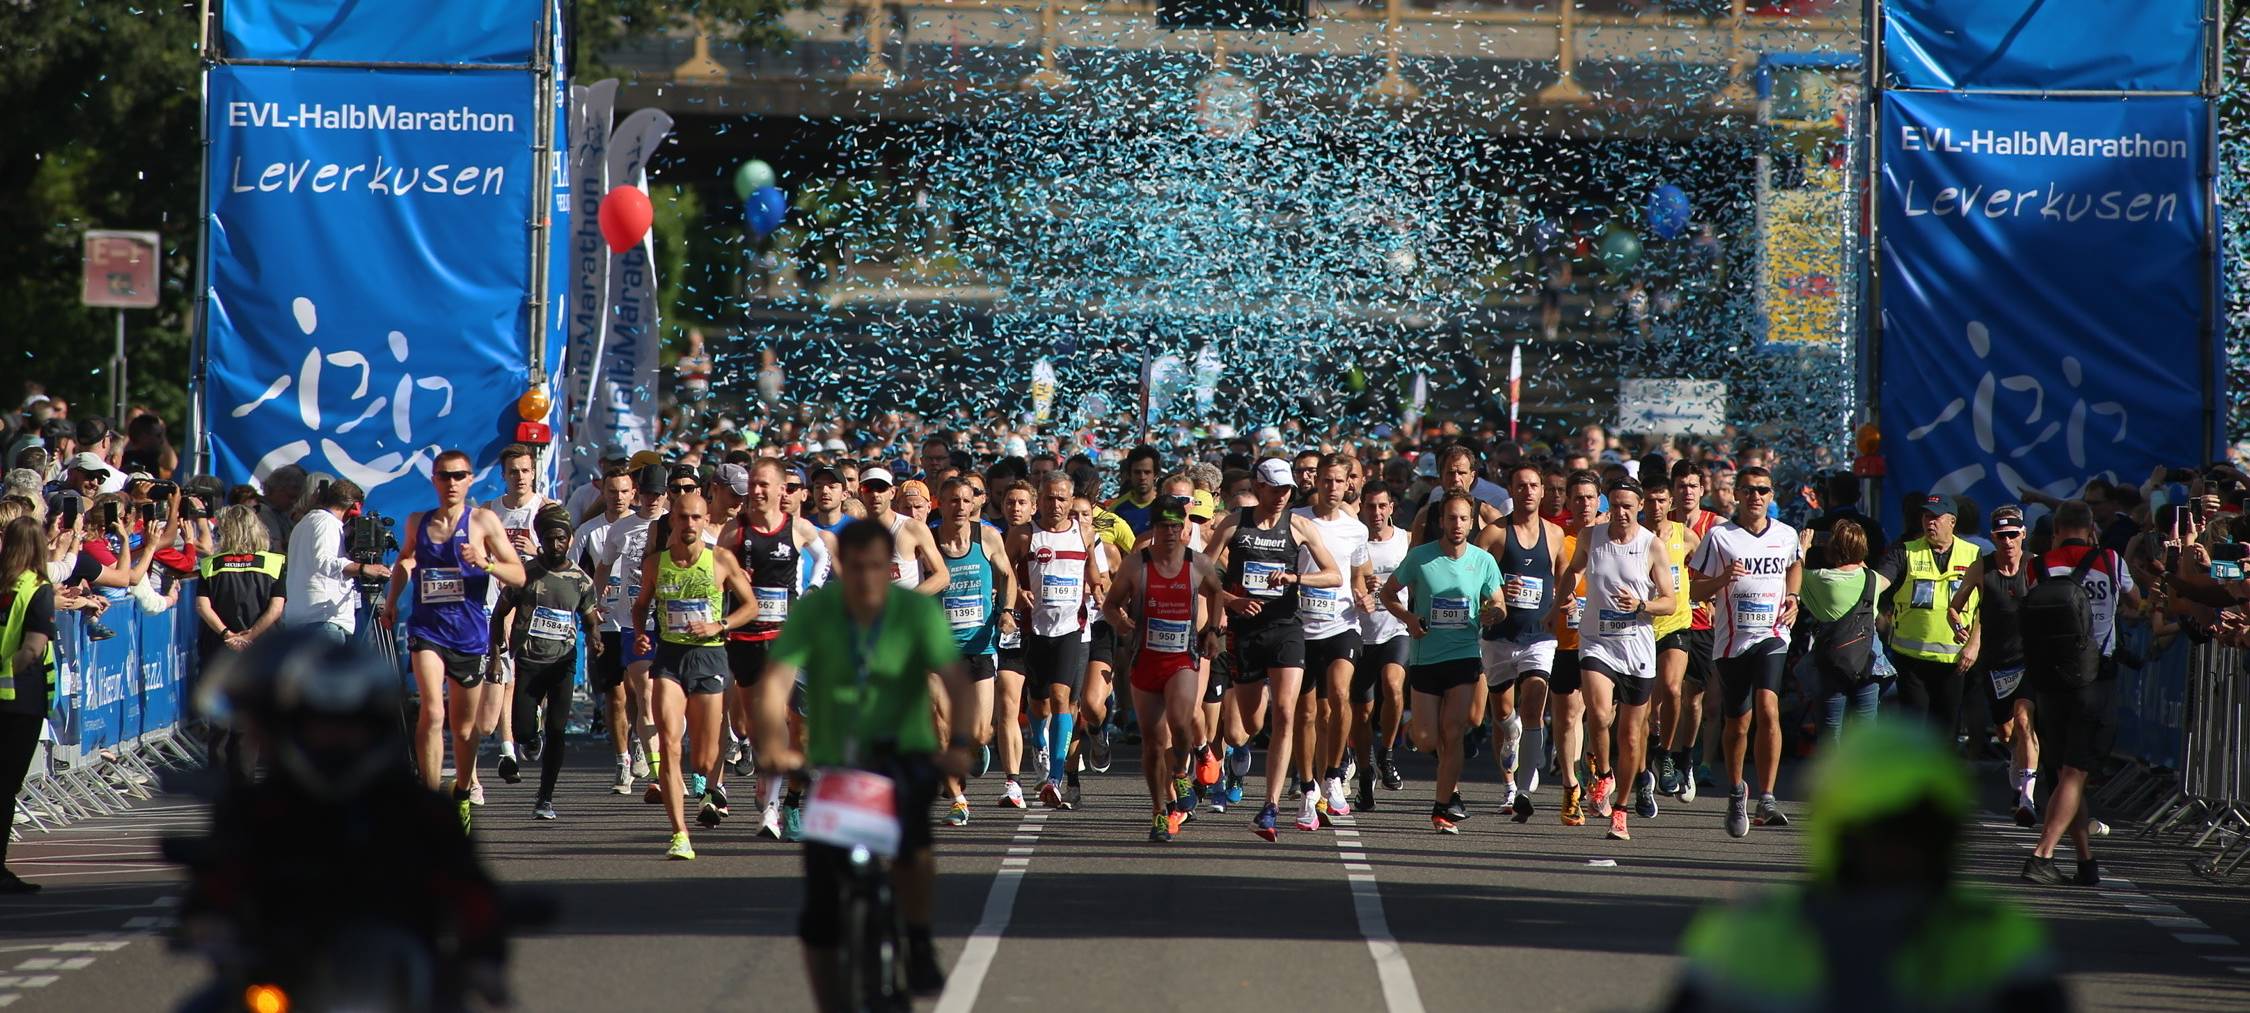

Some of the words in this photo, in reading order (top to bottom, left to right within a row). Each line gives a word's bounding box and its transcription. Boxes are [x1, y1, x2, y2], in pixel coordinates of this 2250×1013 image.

[229, 102, 514, 132] EVL-HalbMarathon
[1901, 126, 2187, 158] EVL-HalbMarathon
[232, 155, 504, 196] Leverkusen
[1904, 180, 2177, 223] Leverkusen
[1254, 536, 1286, 548] bunert
[431, 581, 454, 591] 1359
[945, 580, 982, 591] NGELS
[1054, 587, 1069, 595] 169
[1306, 598, 1328, 608] 1129
[954, 608, 976, 617] 1395
[1443, 611, 1458, 619] 501
[1745, 613, 1767, 621] 1188
[541, 618, 562, 631] 1584
[1610, 621, 1627, 630] 900
[1158, 632, 1176, 641] 950
